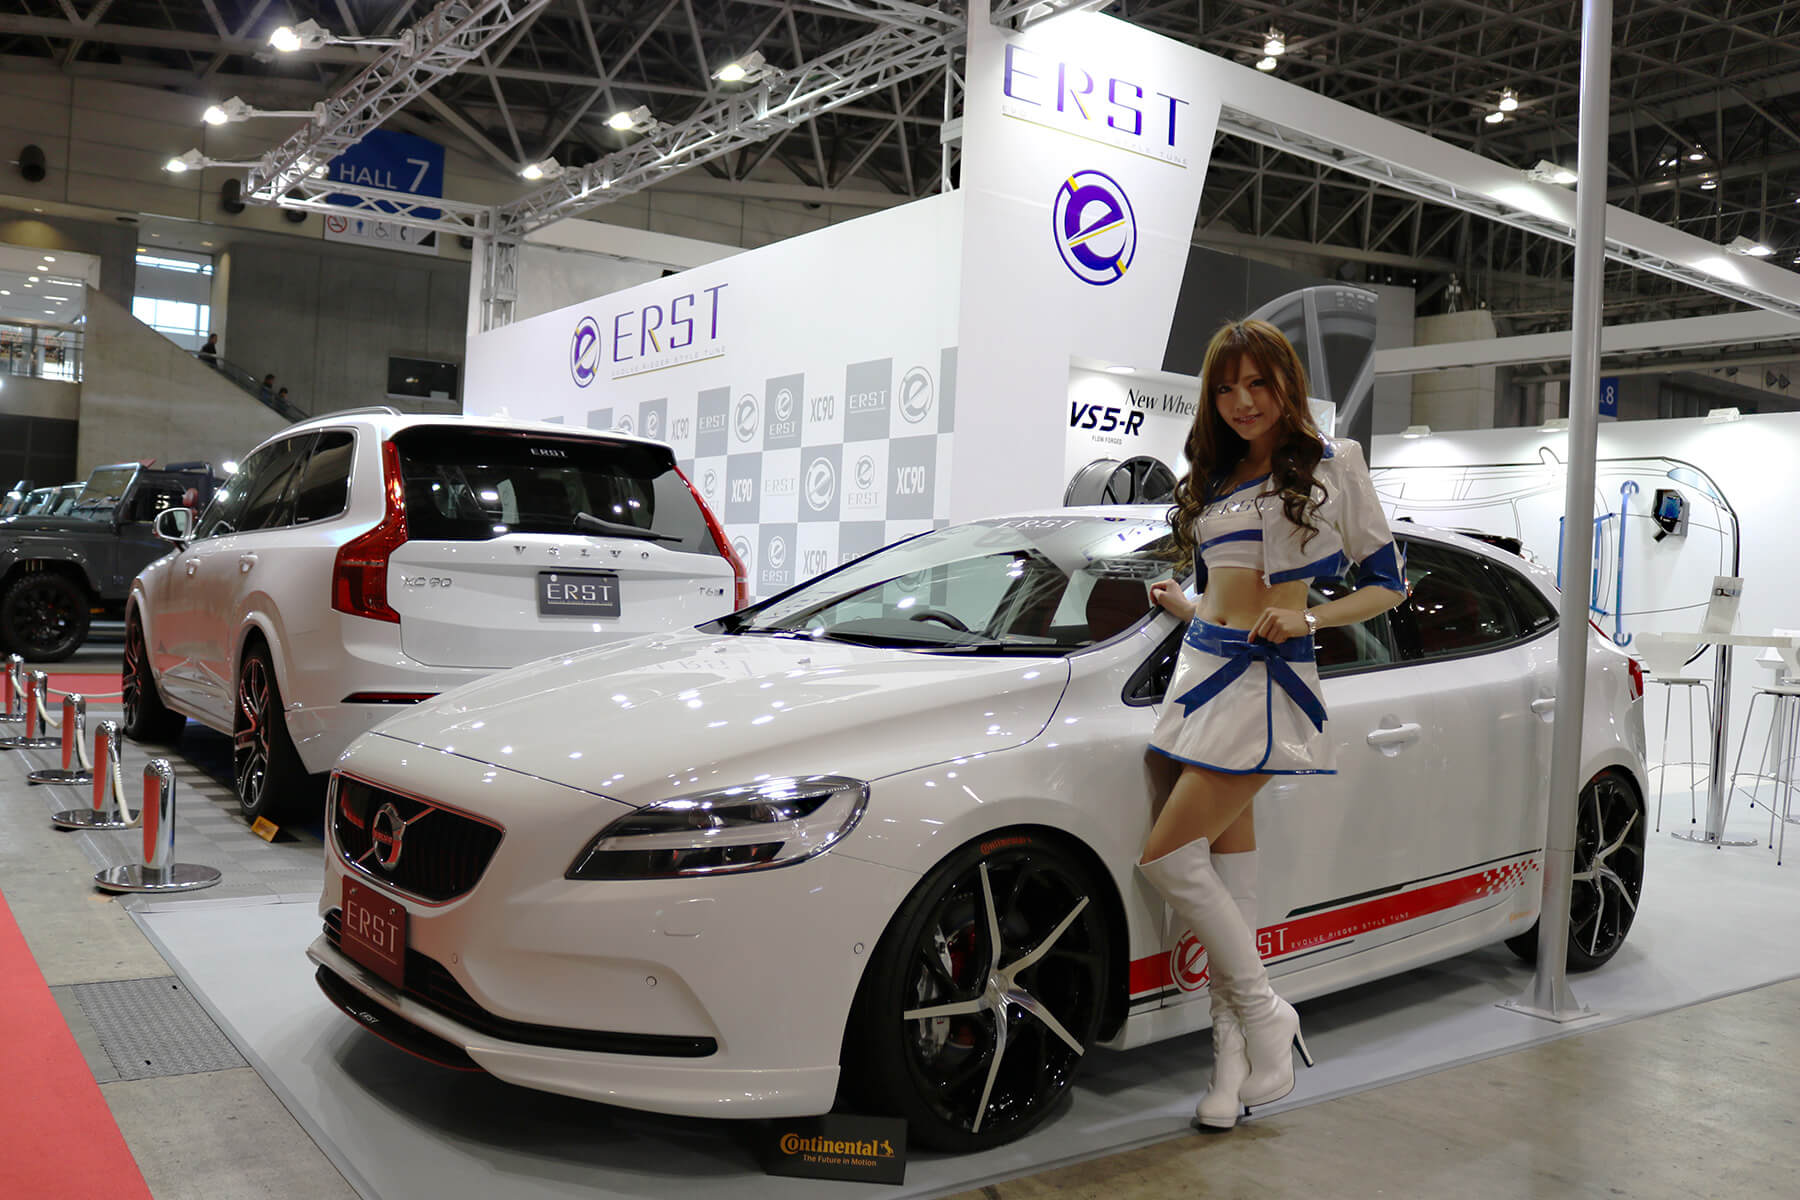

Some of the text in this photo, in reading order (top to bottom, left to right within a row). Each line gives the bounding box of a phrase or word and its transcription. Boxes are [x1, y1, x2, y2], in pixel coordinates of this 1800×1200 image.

[1003, 42, 1191, 148] ERST
[340, 157, 430, 193] HALL 7
[613, 283, 729, 363] ERST
[849, 391, 887, 409] ERST
[1125, 387, 1199, 417] New Whee
[1605, 385, 1615, 405] 8
[699, 413, 727, 430] ERST
[810, 395, 835, 423] XC90
[1070, 401, 1145, 436] VS5-R
[671, 416, 690, 441] XC90
[769, 421, 797, 436] ERST
[731, 478, 753, 503] XC90
[765, 477, 796, 494] ERST
[896, 465, 925, 495] XC90
[848, 491, 879, 506] ERST
[804, 550, 829, 575] XC90
[762, 569, 791, 584] ERST
[547, 583, 613, 602] ERST
[346, 899, 399, 954] ERST
[1258, 928, 1289, 957] ST
[780, 1132, 878, 1157] Continental
[803, 1154, 877, 1167] The Future in Motion
